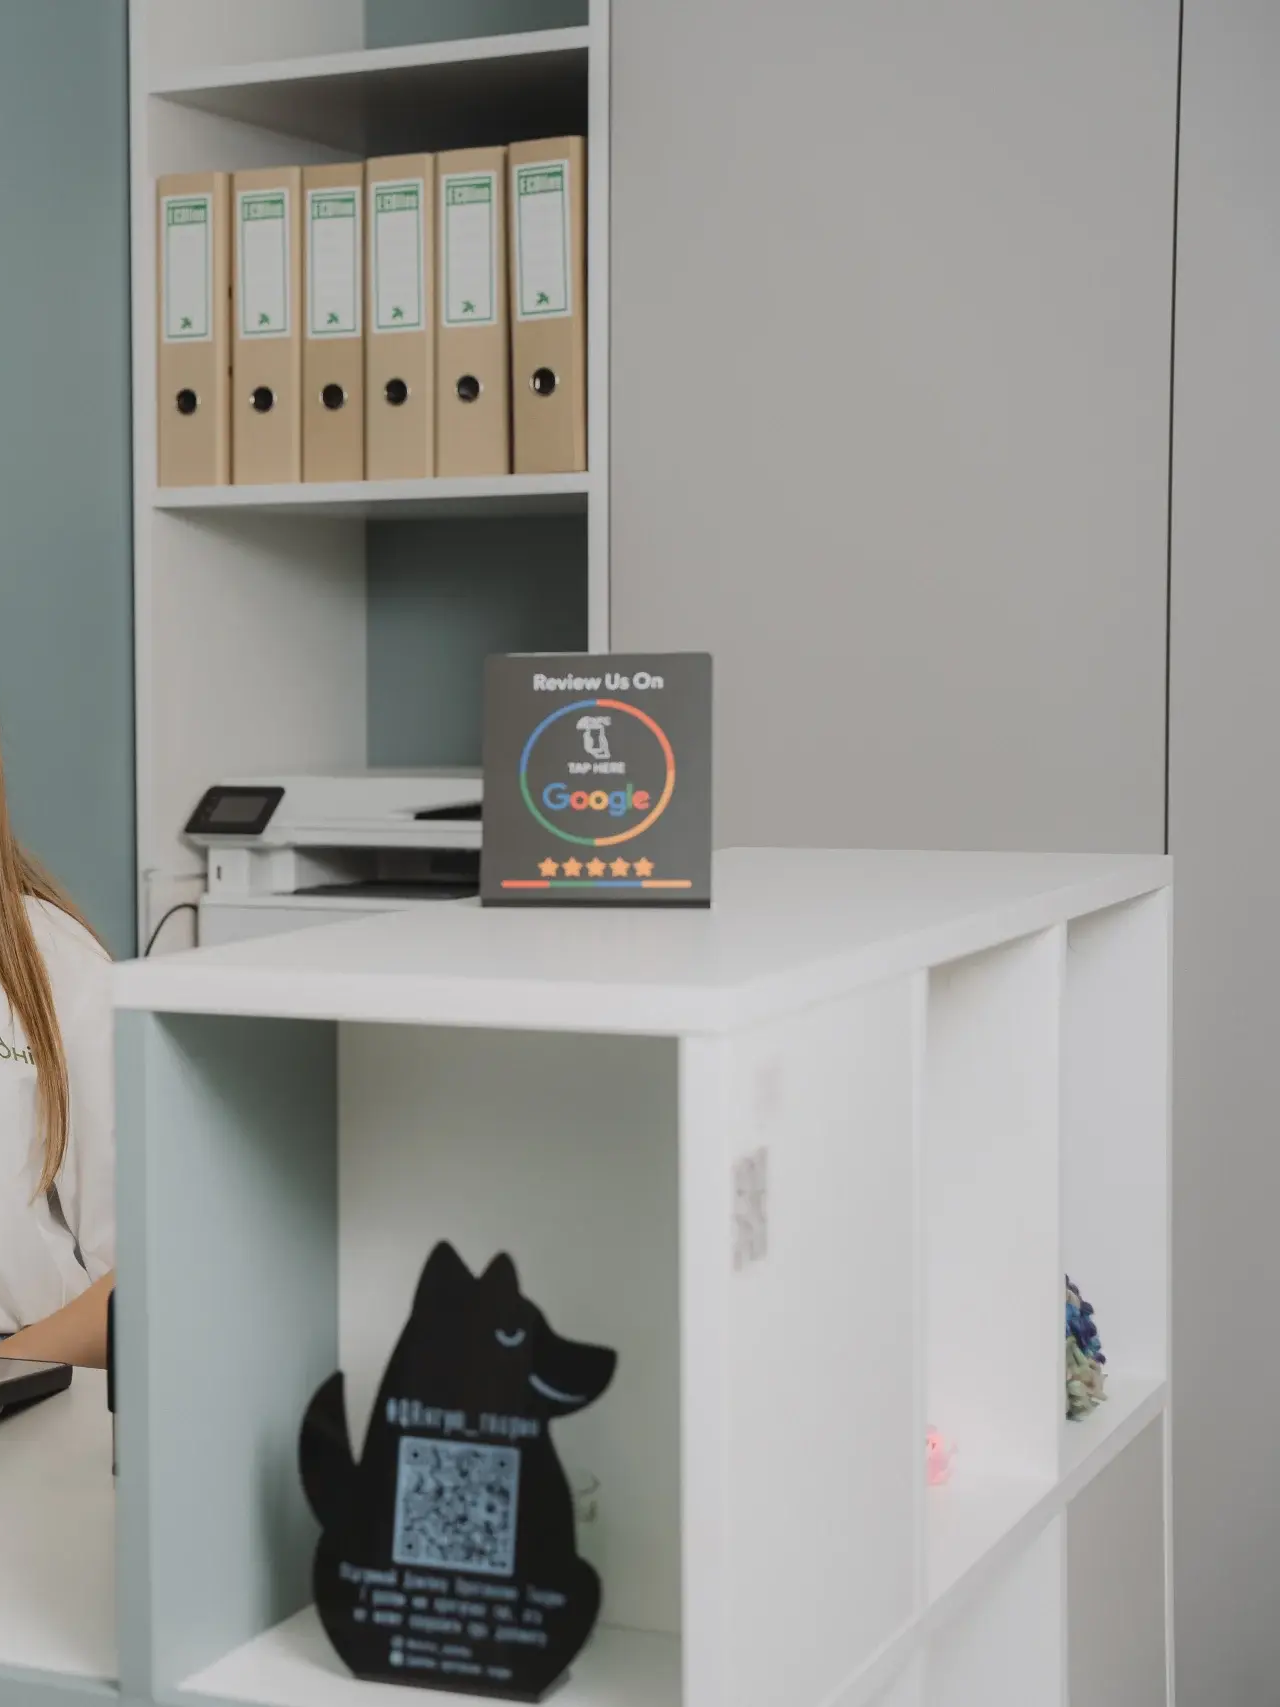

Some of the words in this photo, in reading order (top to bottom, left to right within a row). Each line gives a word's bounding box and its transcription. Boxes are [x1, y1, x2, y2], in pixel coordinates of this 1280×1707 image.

[533, 672, 601, 691] Review
[604, 672, 630, 690] Us
[632, 671, 664, 690] On
[567, 761, 592, 774] TAP
[592, 761, 626, 774] HERE
[542, 782, 651, 817] Google
